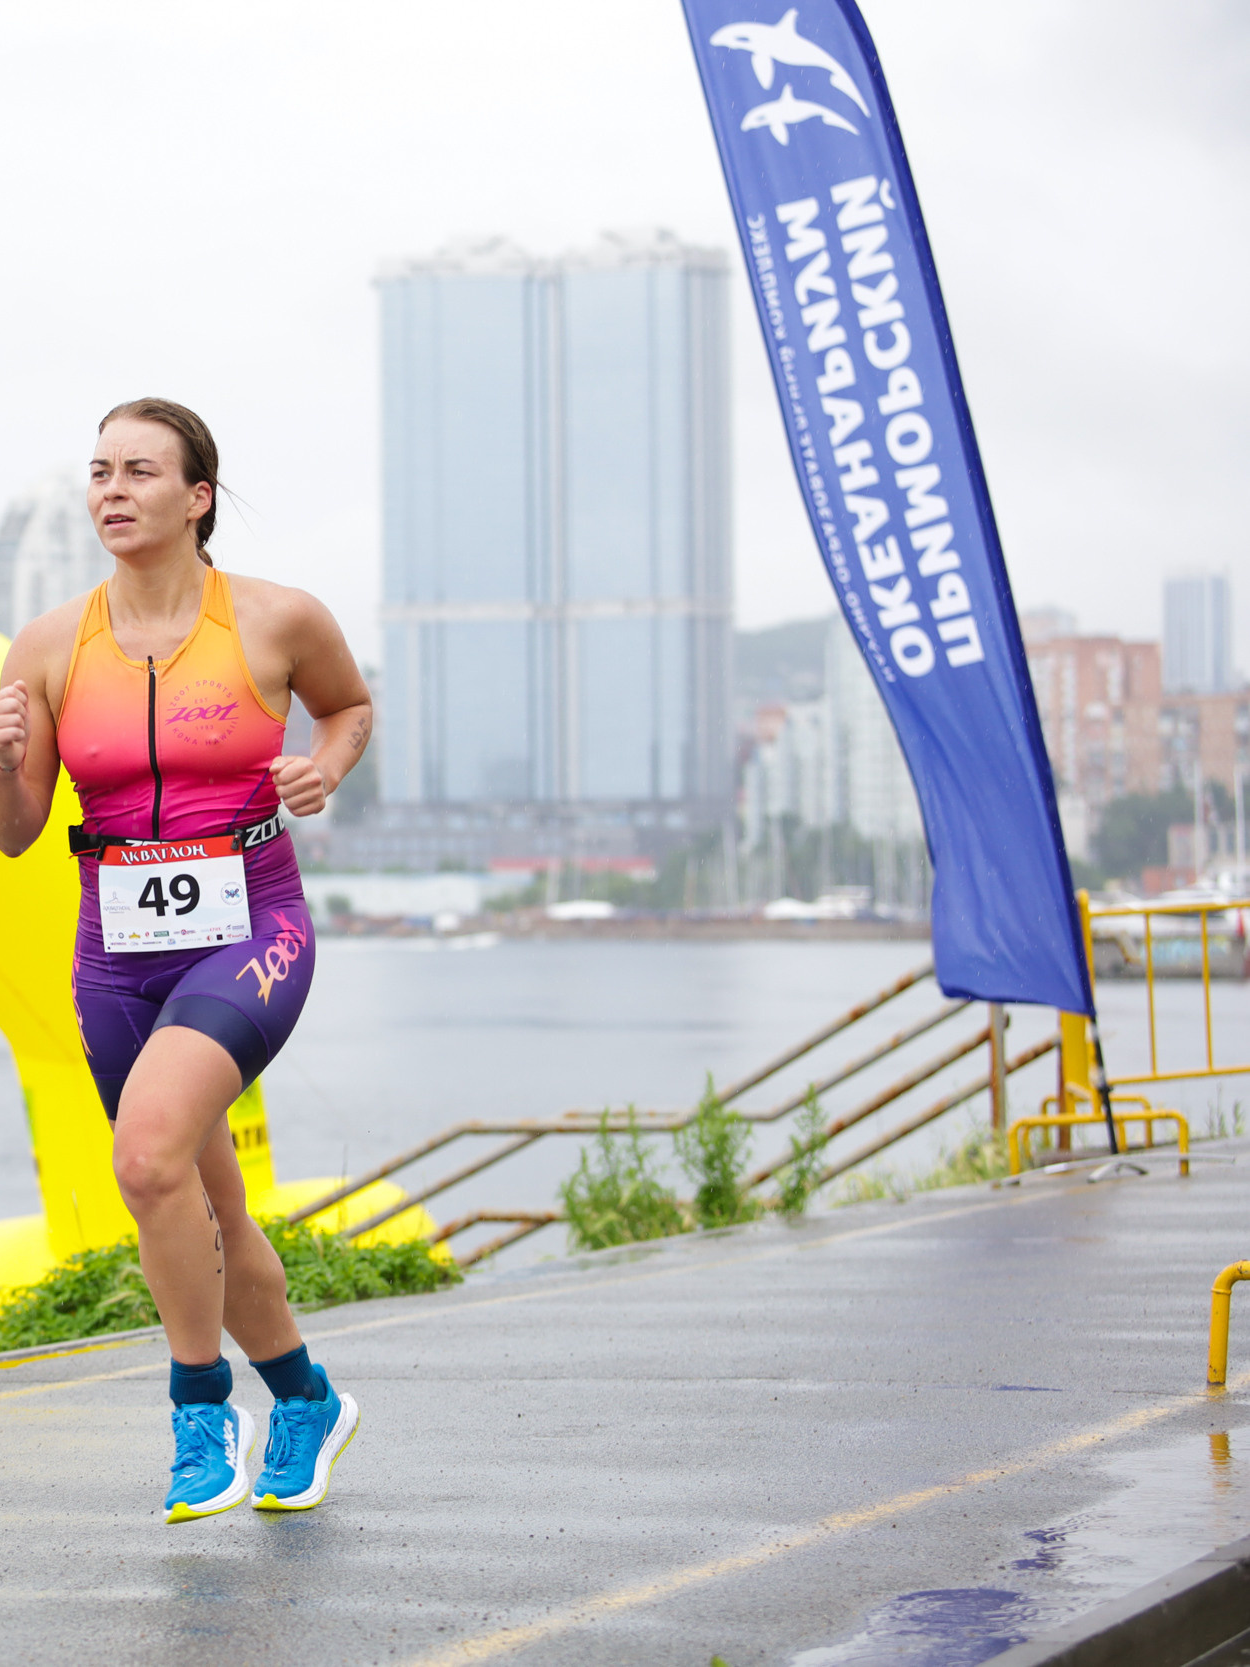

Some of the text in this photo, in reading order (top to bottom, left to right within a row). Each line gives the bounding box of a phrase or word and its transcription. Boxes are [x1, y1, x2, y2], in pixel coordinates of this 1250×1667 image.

[170, 680, 233, 707] ZOOT SPORTS
[173, 721, 238, 746] KONA HAWAII
[137, 873, 201, 917] 49
